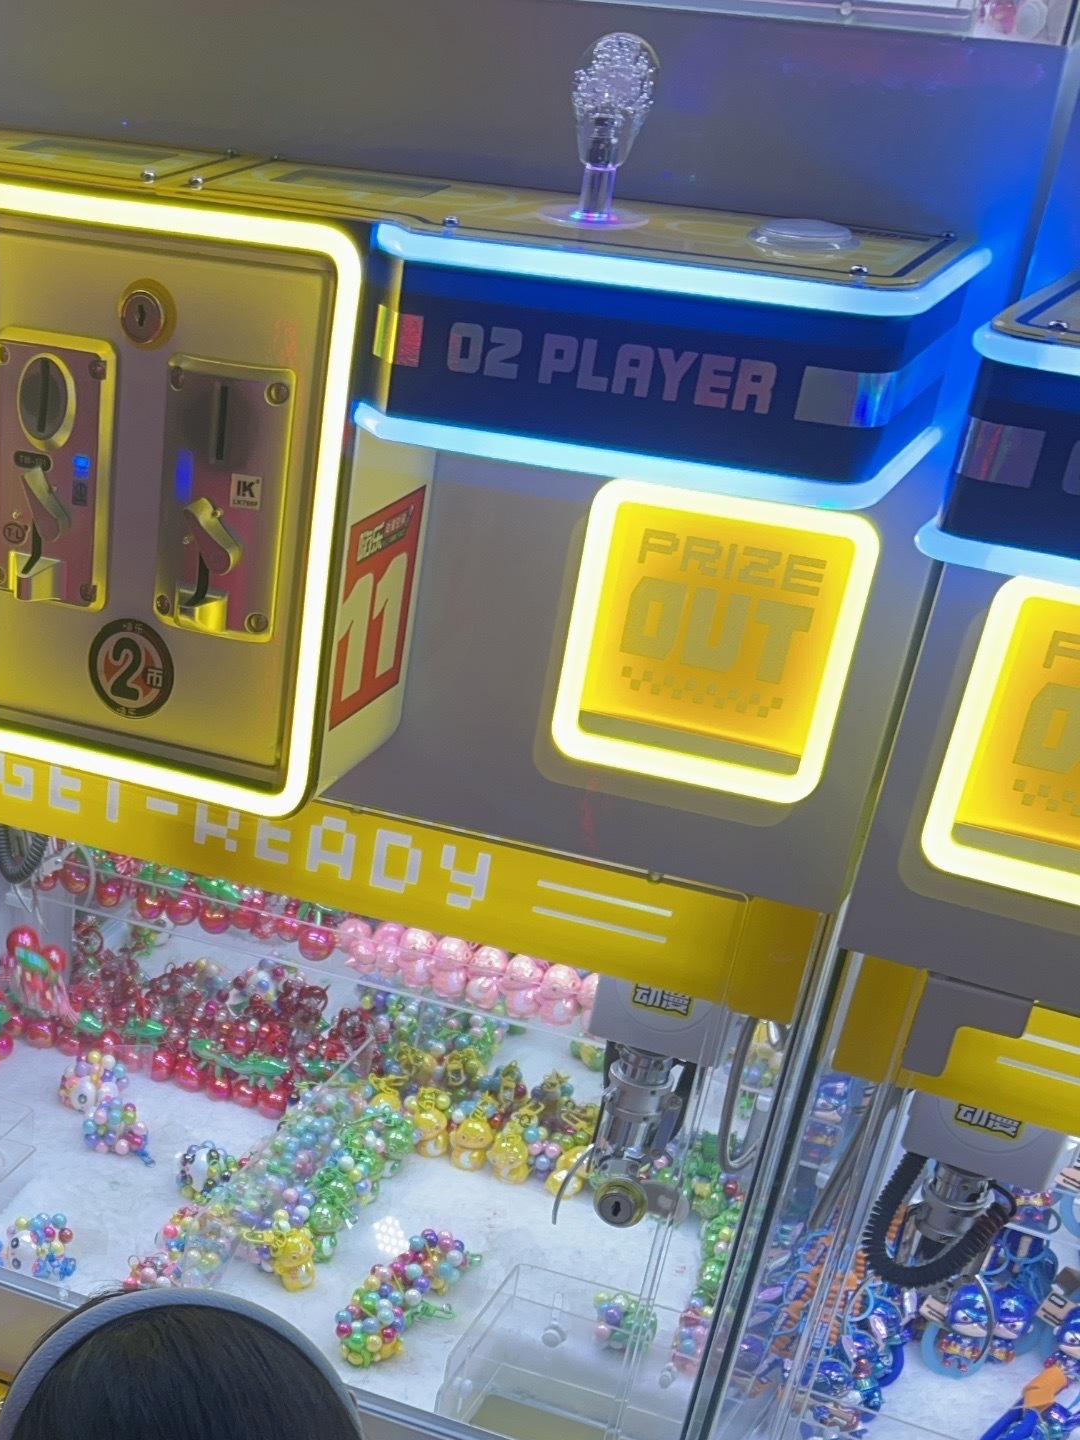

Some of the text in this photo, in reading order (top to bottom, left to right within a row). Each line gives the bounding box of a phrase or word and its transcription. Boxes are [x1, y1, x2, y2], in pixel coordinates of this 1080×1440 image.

[446, 321, 777, 414] 02 PLAYER
[637, 527, 828, 597] PRIZE
[338, 551, 408, 702] 11
[619, 576, 815, 685] OUT
[955, 1103, 1022, 1138] 动漫
